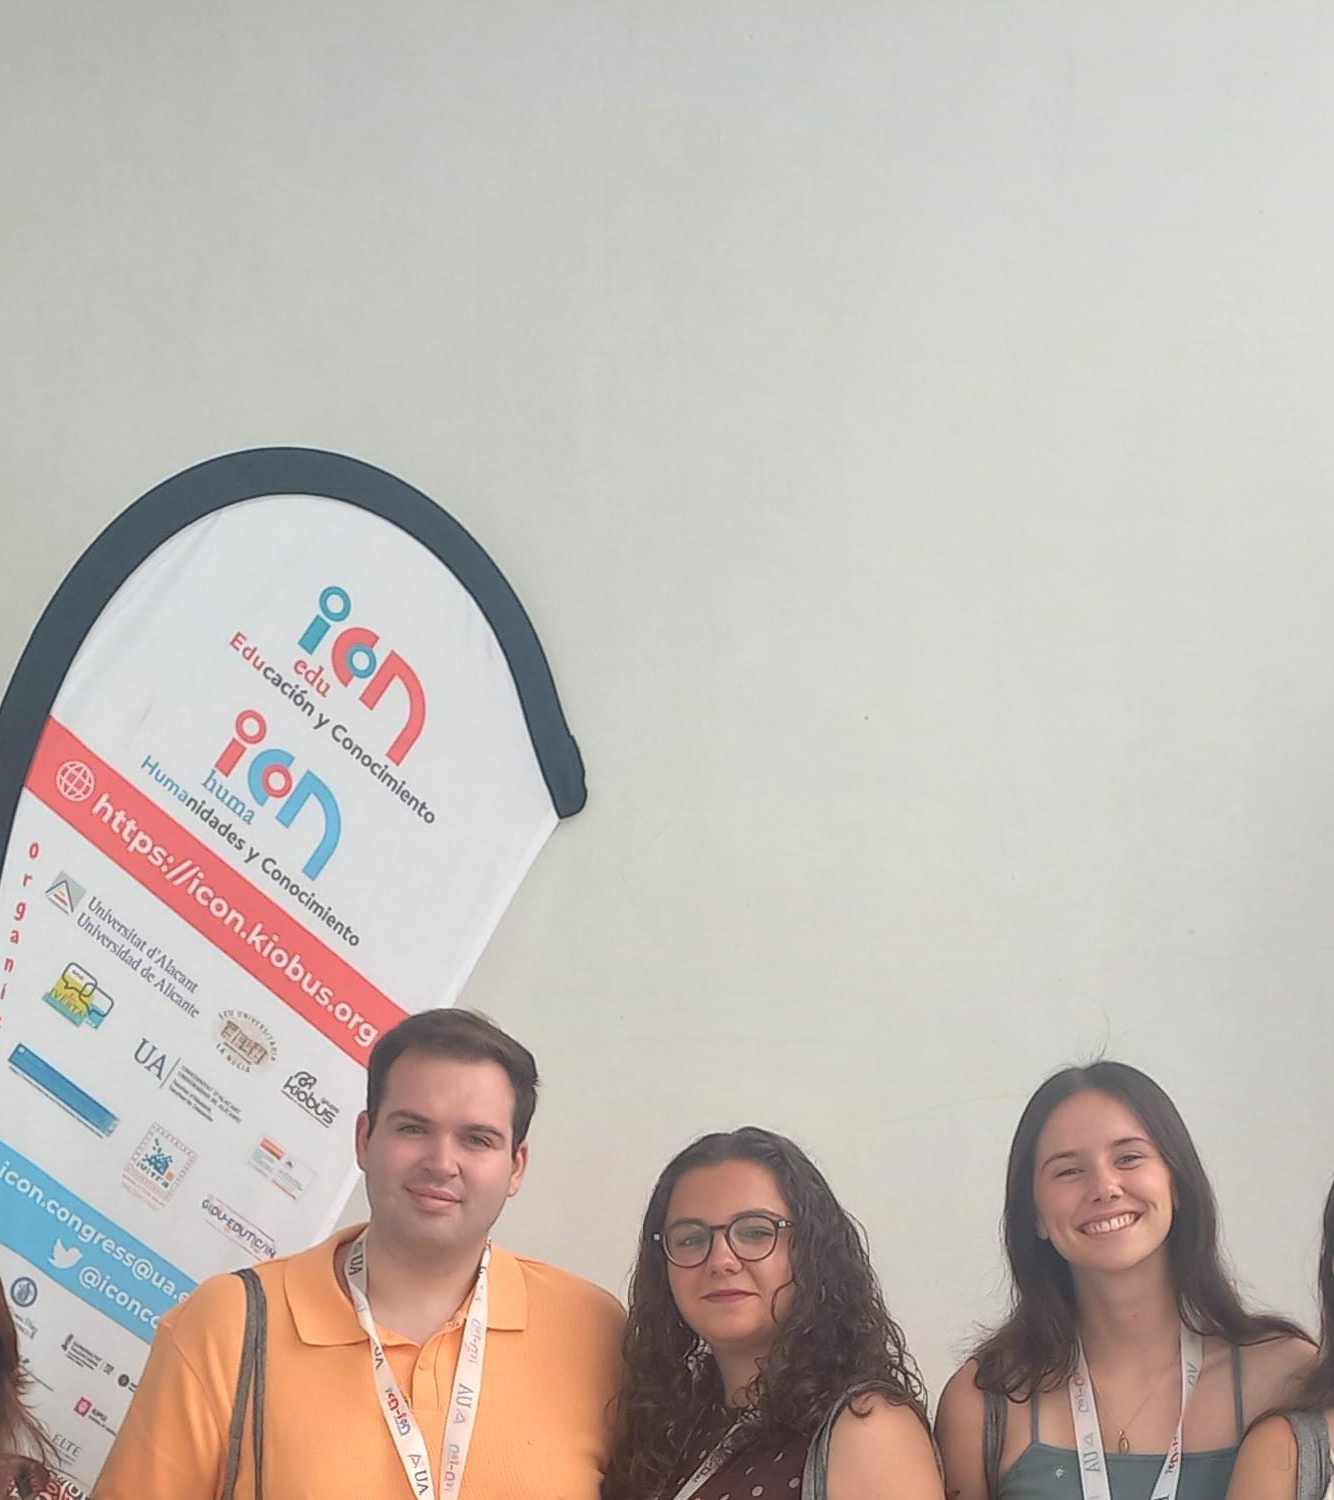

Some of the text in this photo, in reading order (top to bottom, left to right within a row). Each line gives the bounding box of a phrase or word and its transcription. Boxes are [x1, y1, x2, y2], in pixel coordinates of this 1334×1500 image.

[293, 658, 332, 698] edu
[229, 631, 437, 826] Educación y Conocimiento
[201, 768, 257, 827] huma
[140, 754, 362, 948] Humanidades y Conocimiento
[87, 895, 200, 995] Universitat d'Alacant
[91, 790, 379, 1052] https://icon.kiobus.org
[76, 911, 200, 1019] Universidad de Alicante
[133, 1037, 167, 1081] UA
[282, 1075, 336, 1125] kiobus
[348, 1252, 364, 1278] UA
[413, 1467, 429, 1498] UA
